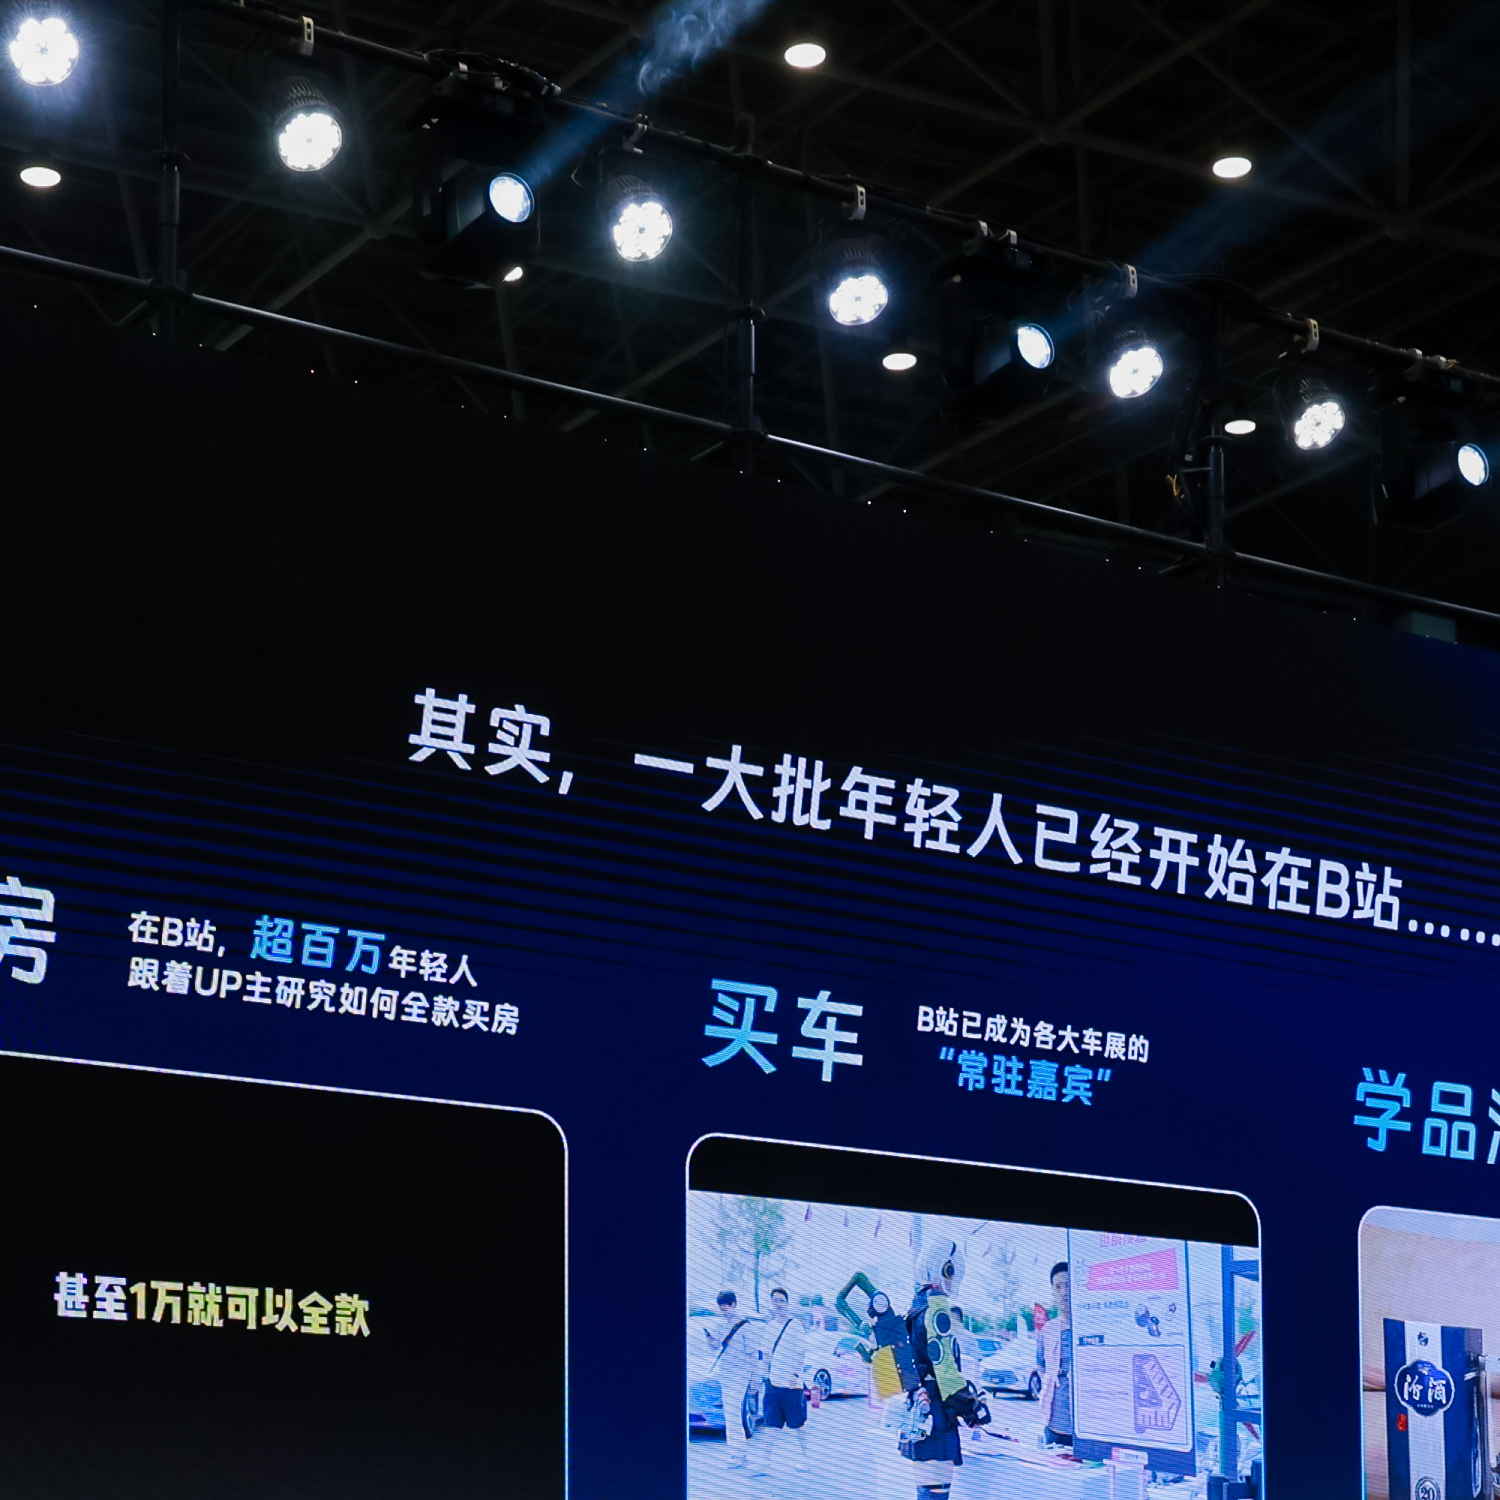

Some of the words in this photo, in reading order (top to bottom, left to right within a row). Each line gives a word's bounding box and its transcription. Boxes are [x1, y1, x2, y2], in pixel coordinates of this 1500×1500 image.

[127, 957, 520, 1036] 跟着UP主研究如何全款买房
[701, 977, 864, 1083] 买车
[917, 1005, 1150, 1064] B站已成为各大车展的
[53, 1271, 372, 1338] 甚至1万就可以全款
